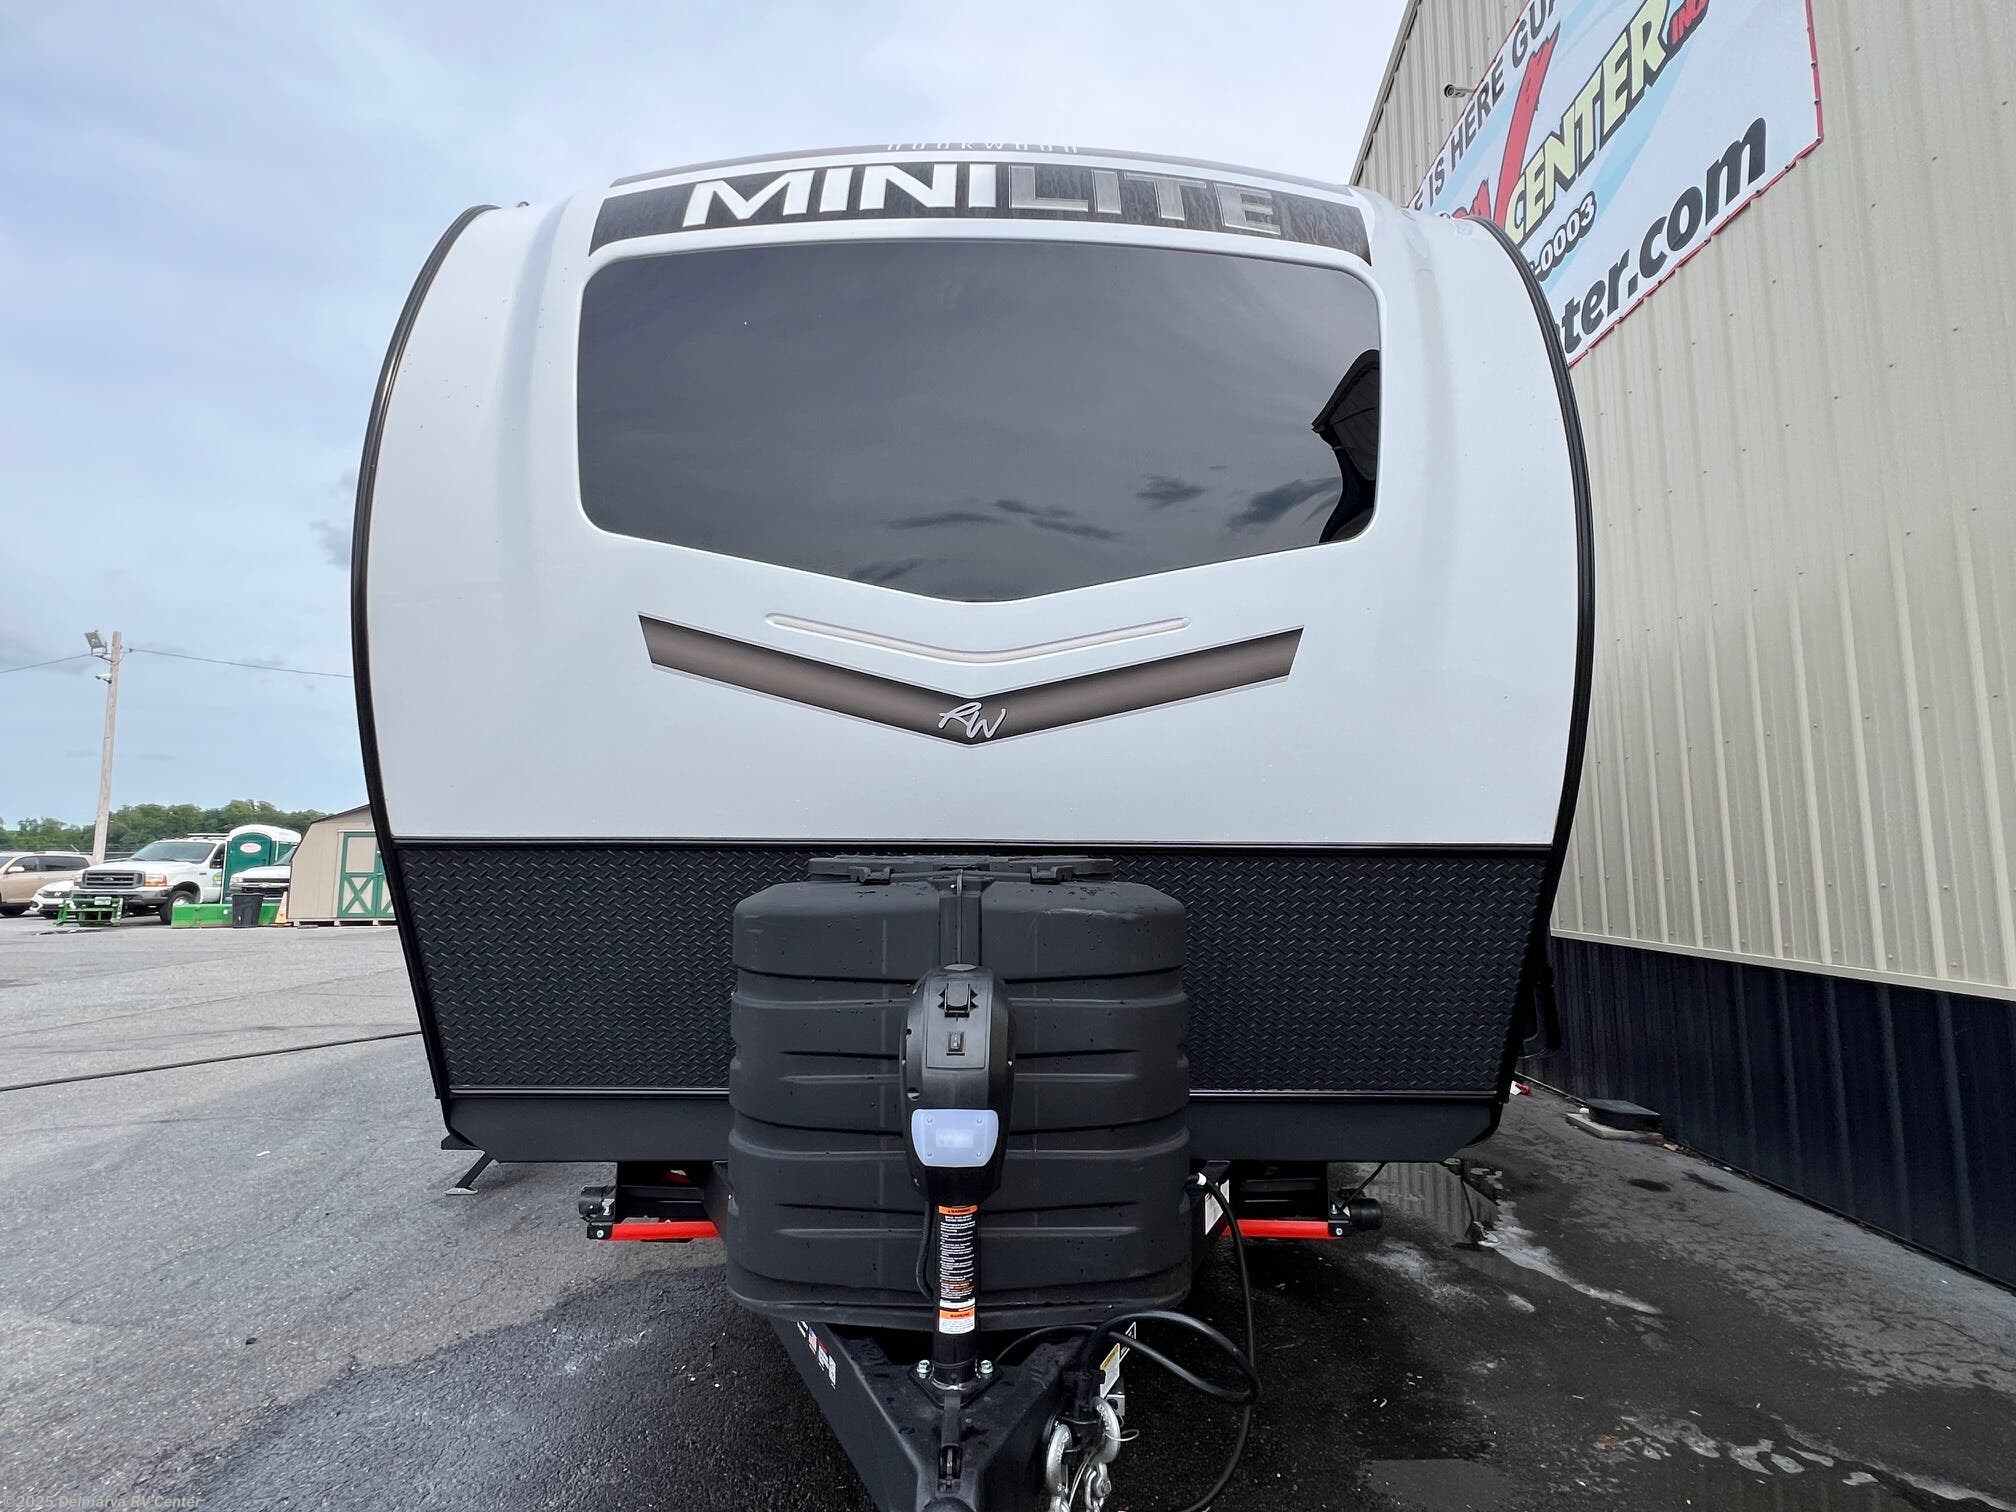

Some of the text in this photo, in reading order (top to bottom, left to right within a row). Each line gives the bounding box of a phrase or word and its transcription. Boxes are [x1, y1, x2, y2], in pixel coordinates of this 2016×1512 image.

[1429, 156, 1446, 208] IS
[1450, 54, 1505, 173] HERE
[1512, 0, 1556, 69] GU
[1505, 0, 1670, 247] CENTER
[1555, 117, 1767, 354] ter.com
